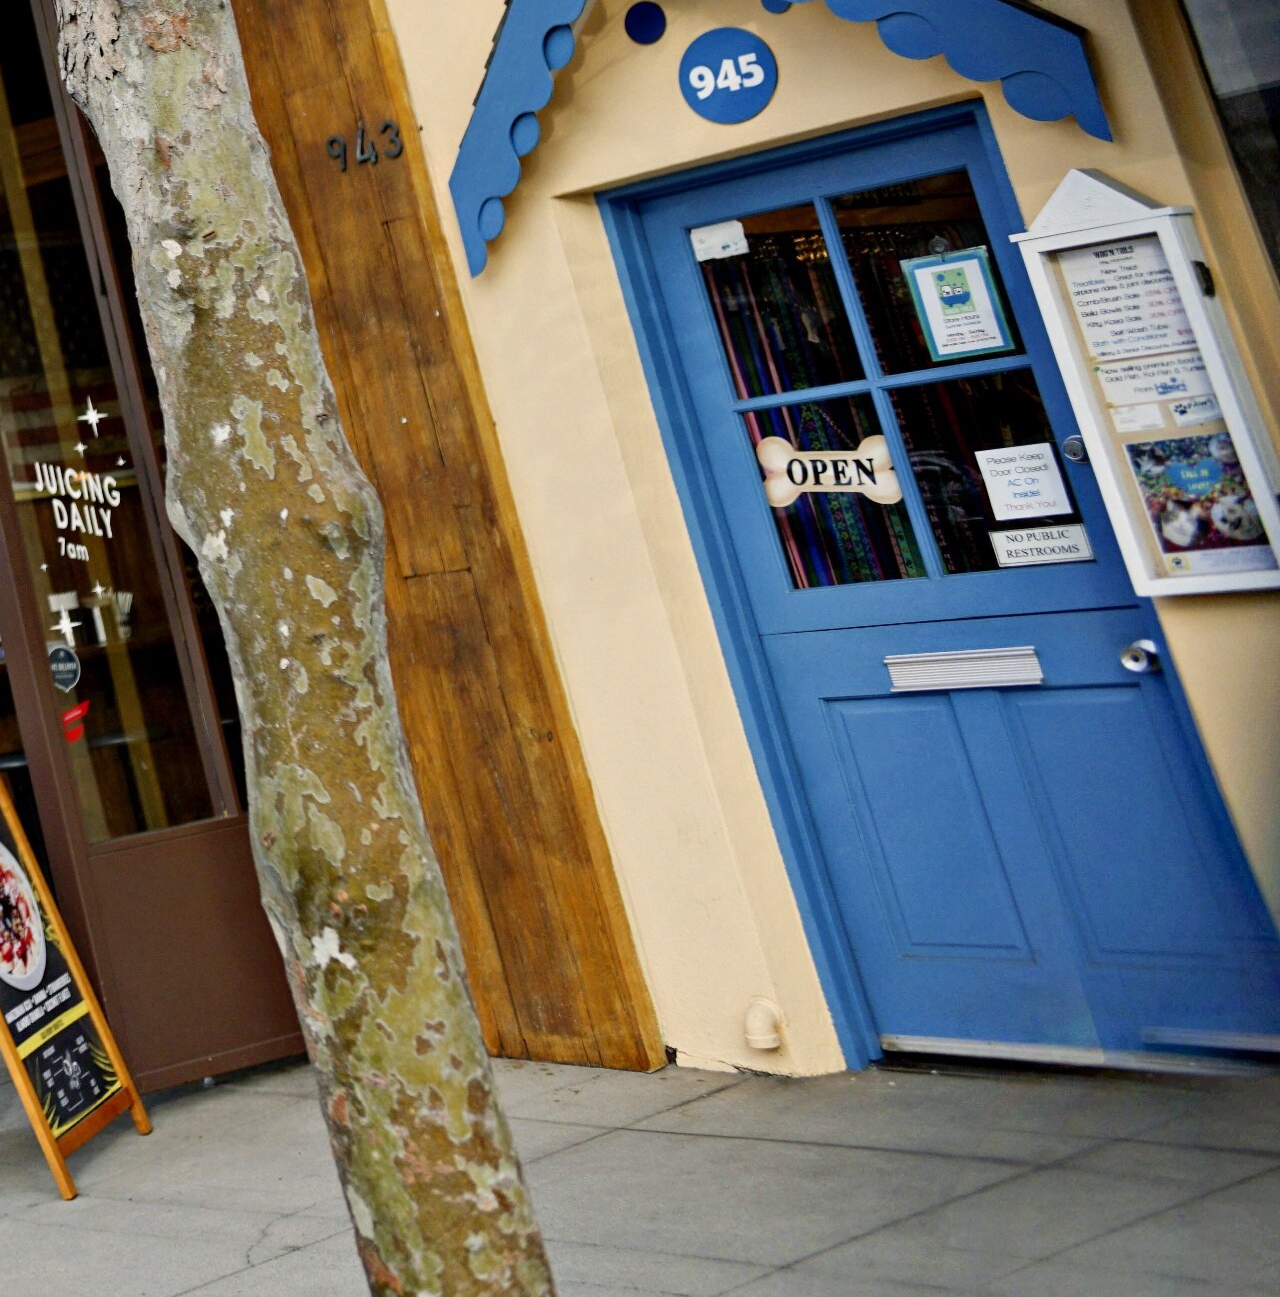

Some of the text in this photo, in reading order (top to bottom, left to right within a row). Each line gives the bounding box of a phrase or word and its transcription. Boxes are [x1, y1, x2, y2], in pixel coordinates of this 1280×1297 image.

[689, 53, 765, 101] 945
[326, 119, 404, 173] 943
[986, 452, 1044, 465] Please Keep
[786, 457, 878, 487] OPEN
[990, 463, 1049, 477] Door Closed!
[34, 461, 121, 507] JUICING
[1007, 477, 1039, 487] AC On
[1005, 499, 1057, 512] Thank You!
[52, 498, 113, 539] DAILY
[1006, 529, 1070, 544] NO PUBLIC
[57, 536, 90, 562] 7am
[1006, 544, 1080, 559] RESTROOMS
